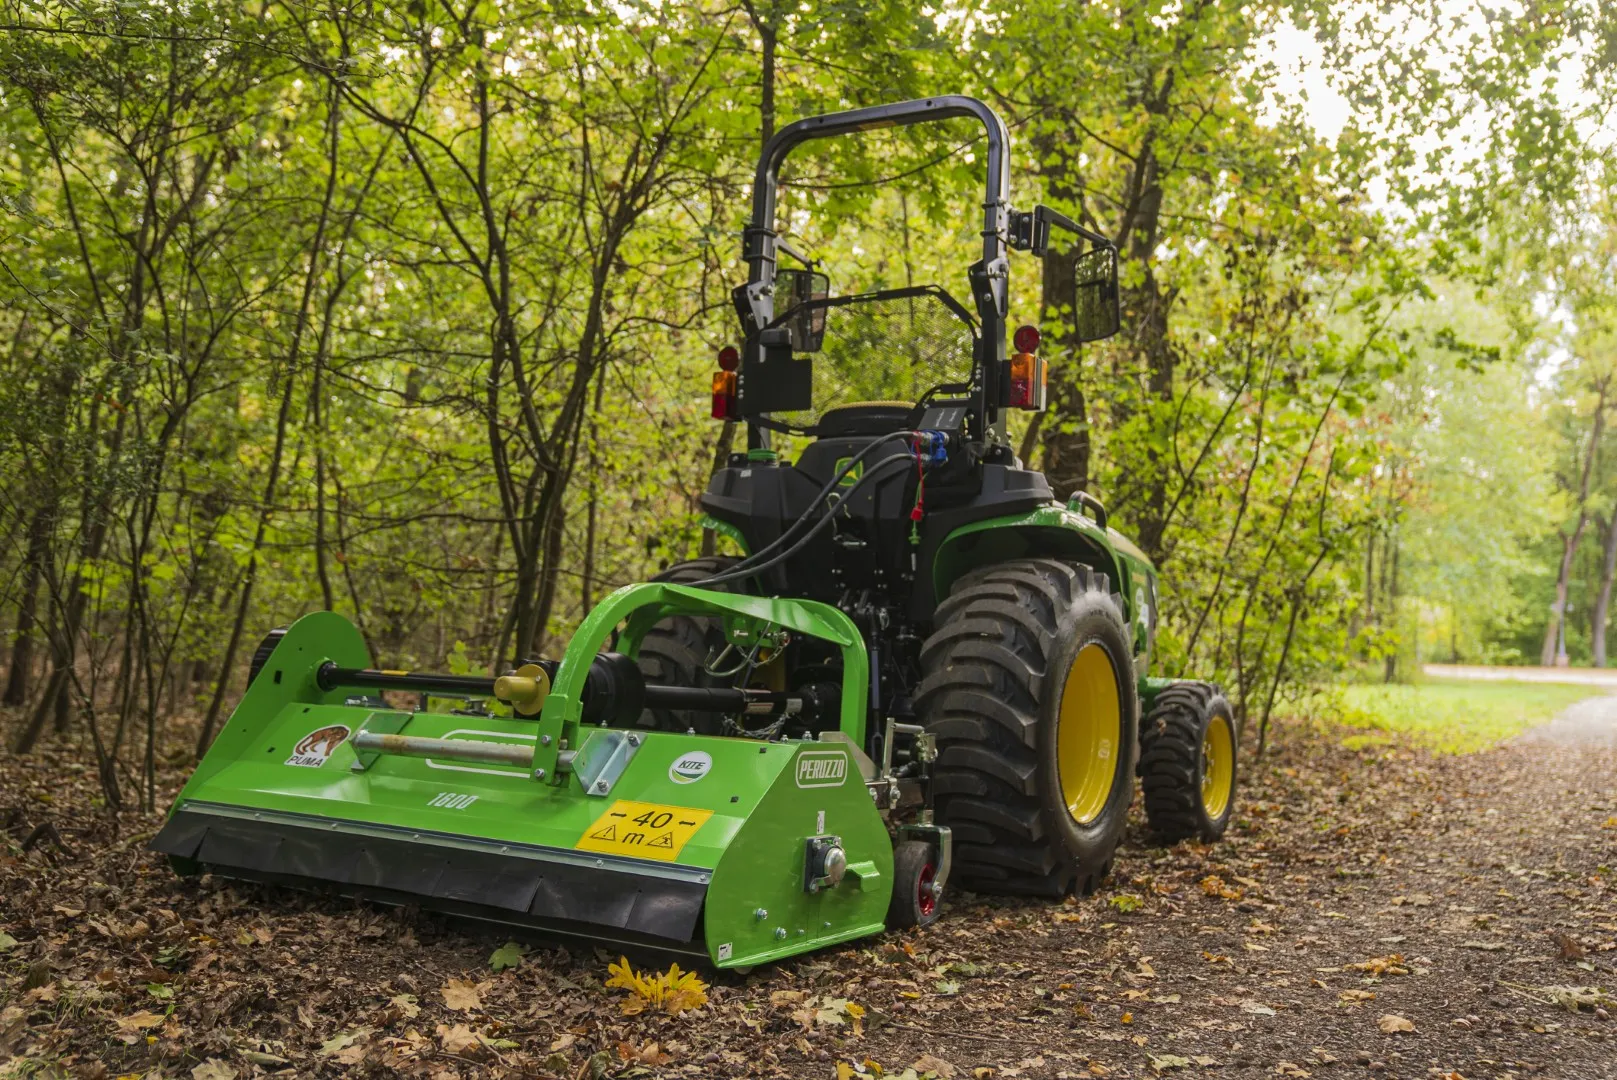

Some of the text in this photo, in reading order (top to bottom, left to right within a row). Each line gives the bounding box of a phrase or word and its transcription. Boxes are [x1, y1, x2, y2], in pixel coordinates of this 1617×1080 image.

[286, 755, 324, 767] PUMA
[677, 760, 706, 770] KITE
[799, 759, 845, 780] PERUZZO
[426, 791, 479, 810] 1600
[632, 810, 673, 829] 40
[622, 832, 645, 845] m
